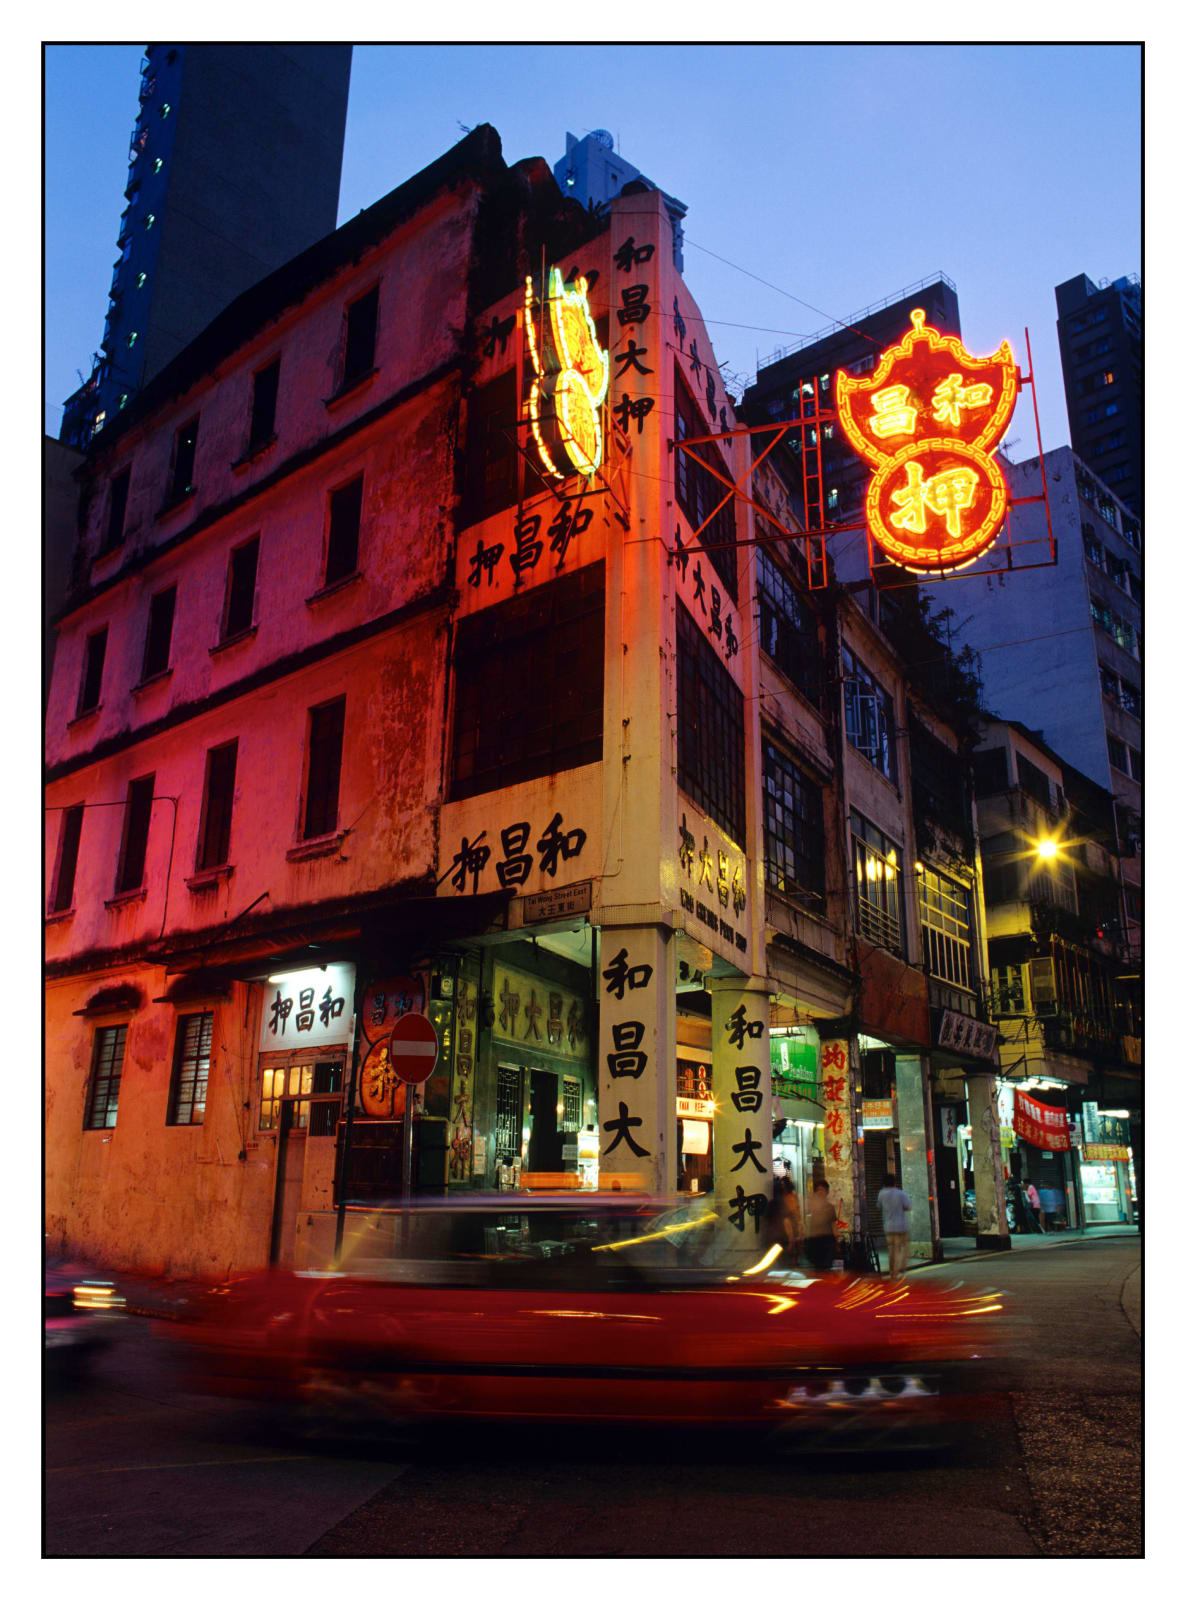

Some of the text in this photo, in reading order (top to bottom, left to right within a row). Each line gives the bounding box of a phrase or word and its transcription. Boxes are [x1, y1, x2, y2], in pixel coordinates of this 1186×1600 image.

[612, 235, 656, 435] 和昌大押
[869, 373, 994, 438] 和昌
[890, 461, 979, 538] 押
[448, 812, 588, 894] 和昌押
[573, 887, 586, 897] East
[269, 986, 346, 1036] 和昌押
[725, 1003, 768, 1234] 和昌大押
